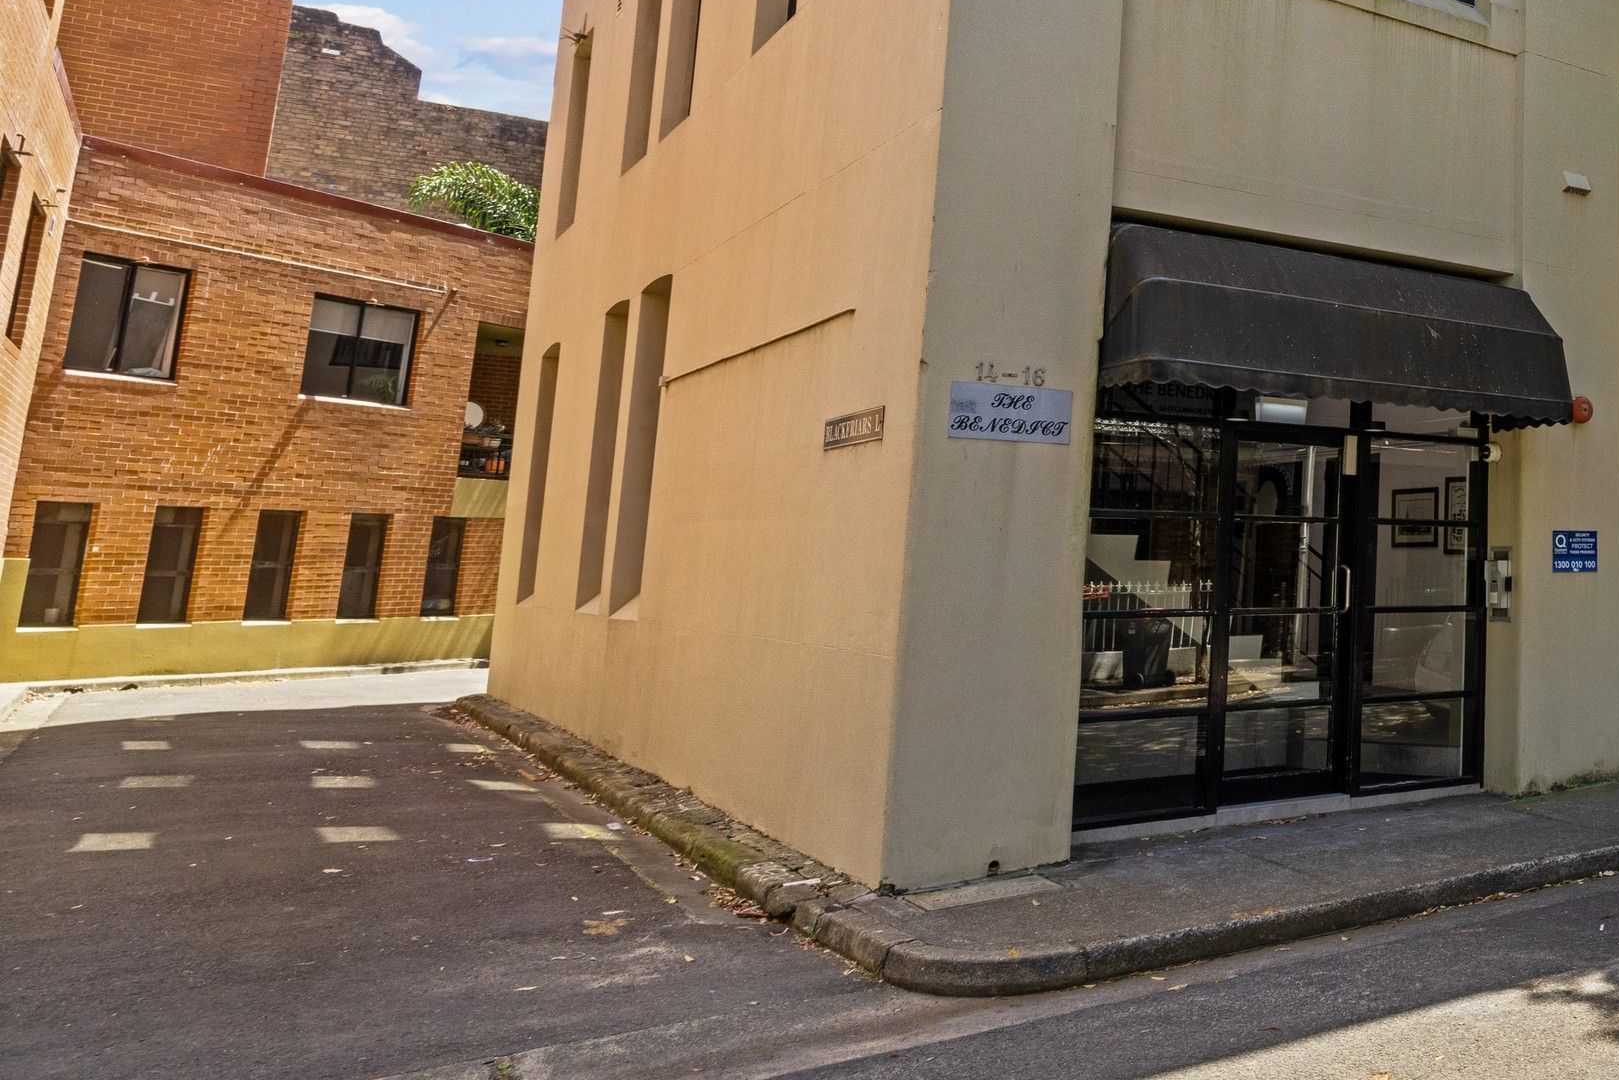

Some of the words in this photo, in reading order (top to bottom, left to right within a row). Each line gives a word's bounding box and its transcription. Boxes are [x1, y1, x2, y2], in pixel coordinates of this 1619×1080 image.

[991, 392, 1035, 411] THE
[950, 414, 1069, 437] BENEDICT
[1554, 560, 1570, 569] 1300
[1570, 560, 1583, 569] 010
[1584, 560, 1596, 569] 100
